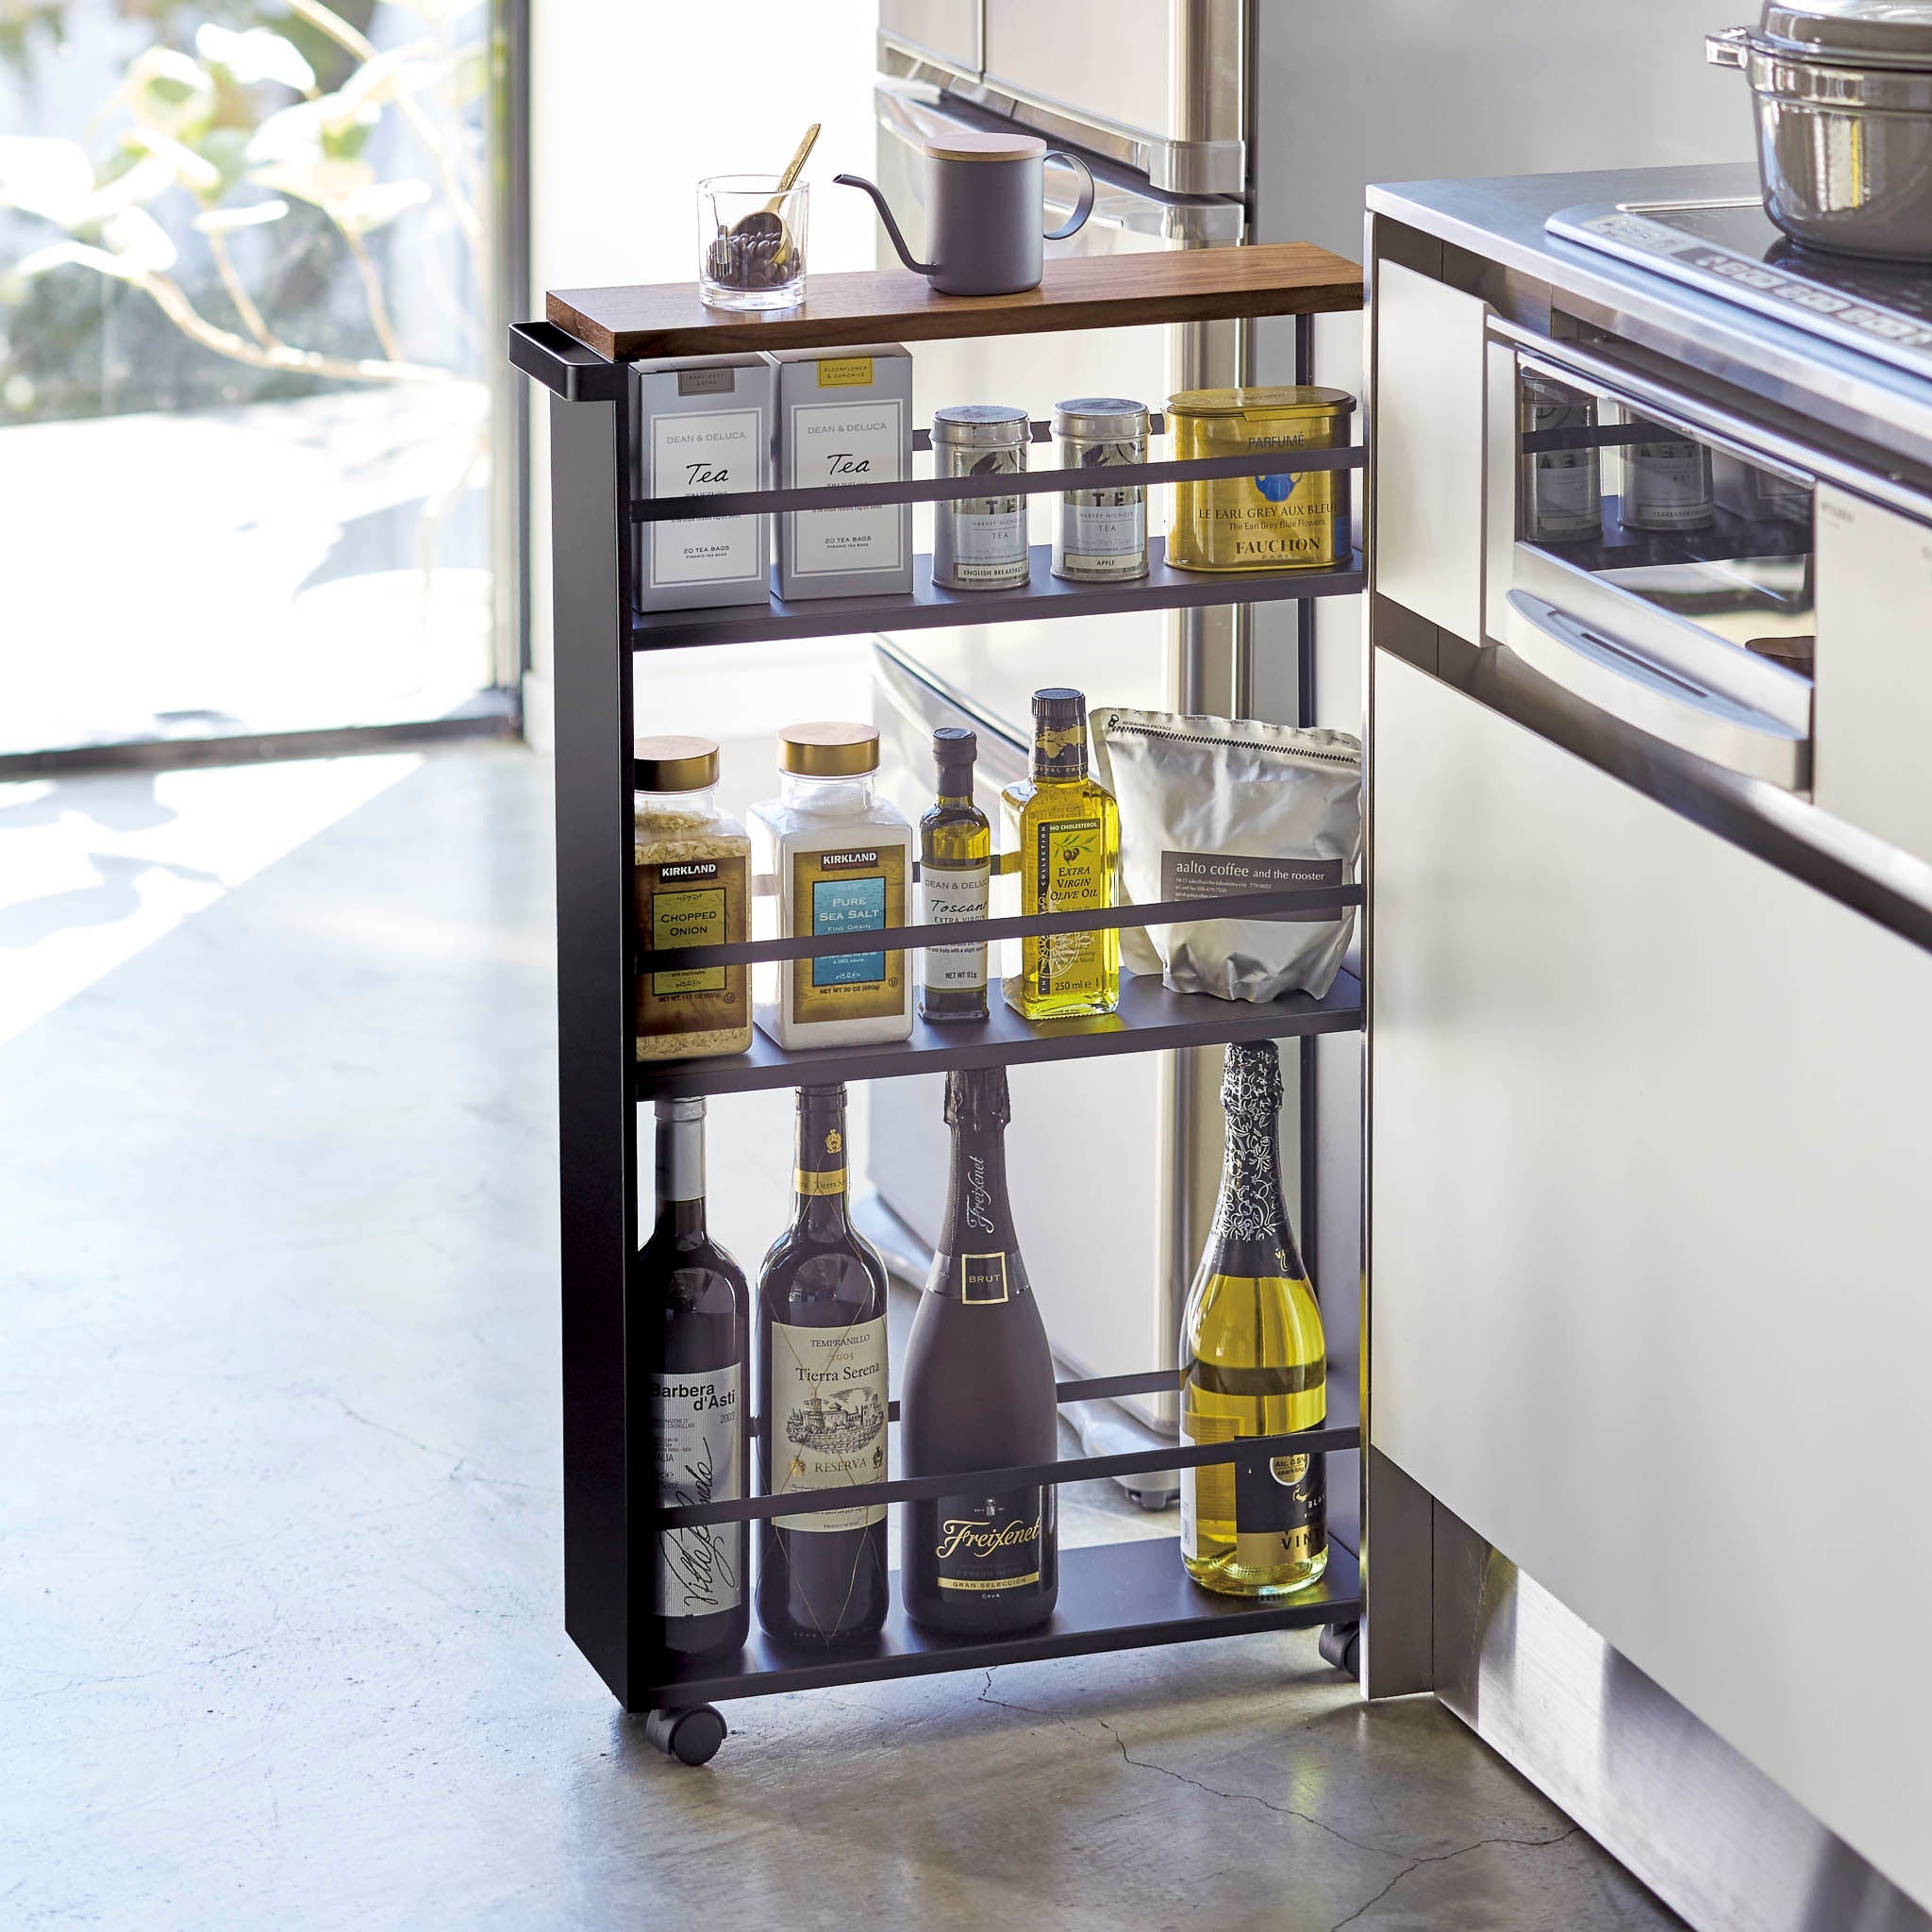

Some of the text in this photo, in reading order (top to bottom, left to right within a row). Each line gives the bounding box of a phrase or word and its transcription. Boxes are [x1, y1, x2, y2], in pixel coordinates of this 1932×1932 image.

[808, 422, 887, 434] DEAN & DELUCA
[666, 431, 746, 444] DEAN & DELUCA
[1248, 432, 1306, 448] PARFUMÉ
[827, 454, 871, 475] Tea
[686, 463, 729, 485] Tea
[1199, 509, 1211, 519] LE
[1216, 508, 1244, 519] EARL
[1247, 507, 1277, 518] GREY
[1281, 506, 1304, 516] AUX
[1229, 519, 1326, 531] The Earl Grey Blue Flowers
[1236, 537, 1321, 555] FAUCHON
[993, 566, 1024, 575] BREAKFAST
[1060, 822, 1097, 830] CHOLESTEROL
[823, 852, 877, 865] KIRKLAND
[661, 864, 717, 876] KIRKLAND
[1058, 866, 1091, 876] EXTRA
[1176, 860, 1324, 881] aalto coffee and the rooster
[924, 878, 949, 890] DEAN
[1057, 878, 1091, 888] VIRGIN
[1050, 888, 1098, 901] OLIVE OIL
[832, 897, 866, 907] PURE
[660, 911, 717, 923] CHOPPED
[820, 909, 879, 922] SEA SALT
[670, 926, 708, 937] ONION
[1055, 981, 1071, 991] 250
[1072, 980, 1083, 989] ml
[966, 1155, 995, 1234] Freixenet
[969, 1274, 1001, 1283] BRUT
[810, 1333, 871, 1348] TEMPRANILLO
[830, 1353, 854, 1361] 2005
[795, 1362, 880, 1382] Tierra Serena
[693, 1389, 735, 1411] d'Asti
[815, 1457, 867, 1473] RESERVA
[936, 1513, 1041, 1558] Freixenet
[980, 1577, 1027, 1589] SELECCIÓN
